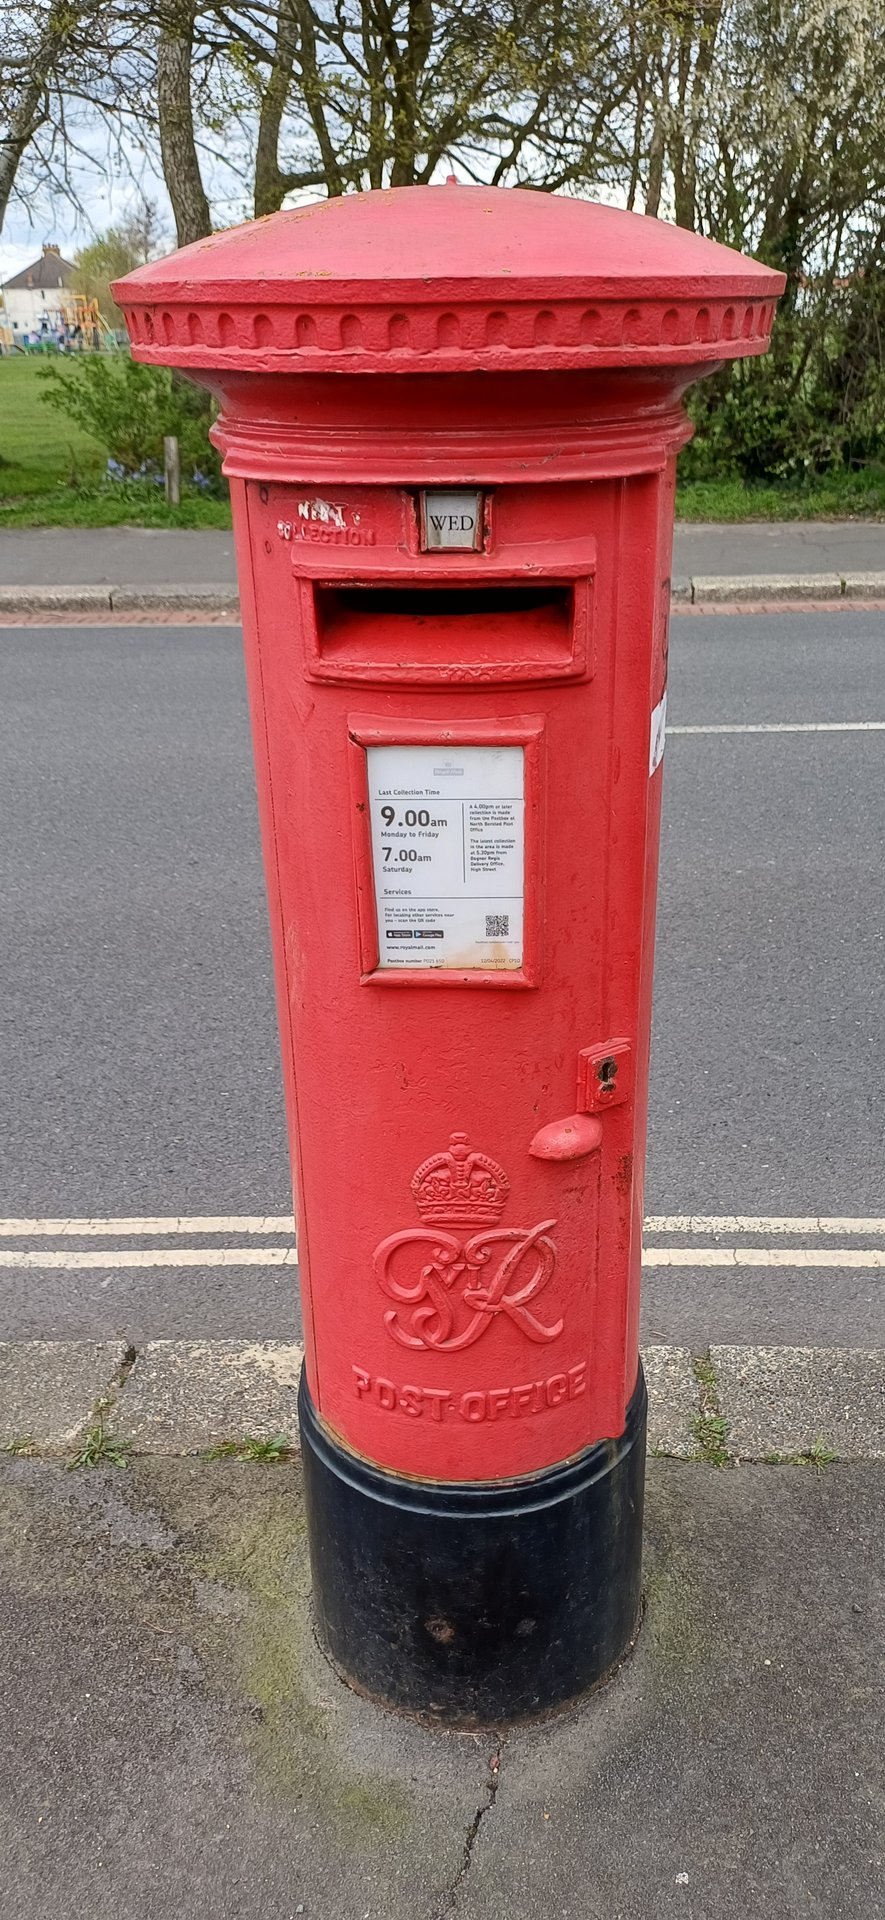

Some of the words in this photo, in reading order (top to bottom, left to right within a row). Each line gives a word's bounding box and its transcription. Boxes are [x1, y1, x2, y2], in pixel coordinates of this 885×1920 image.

[430, 515, 474, 531] WED
[381, 806, 448, 827] 9.00am
[382, 847, 432, 862] 7.00am
